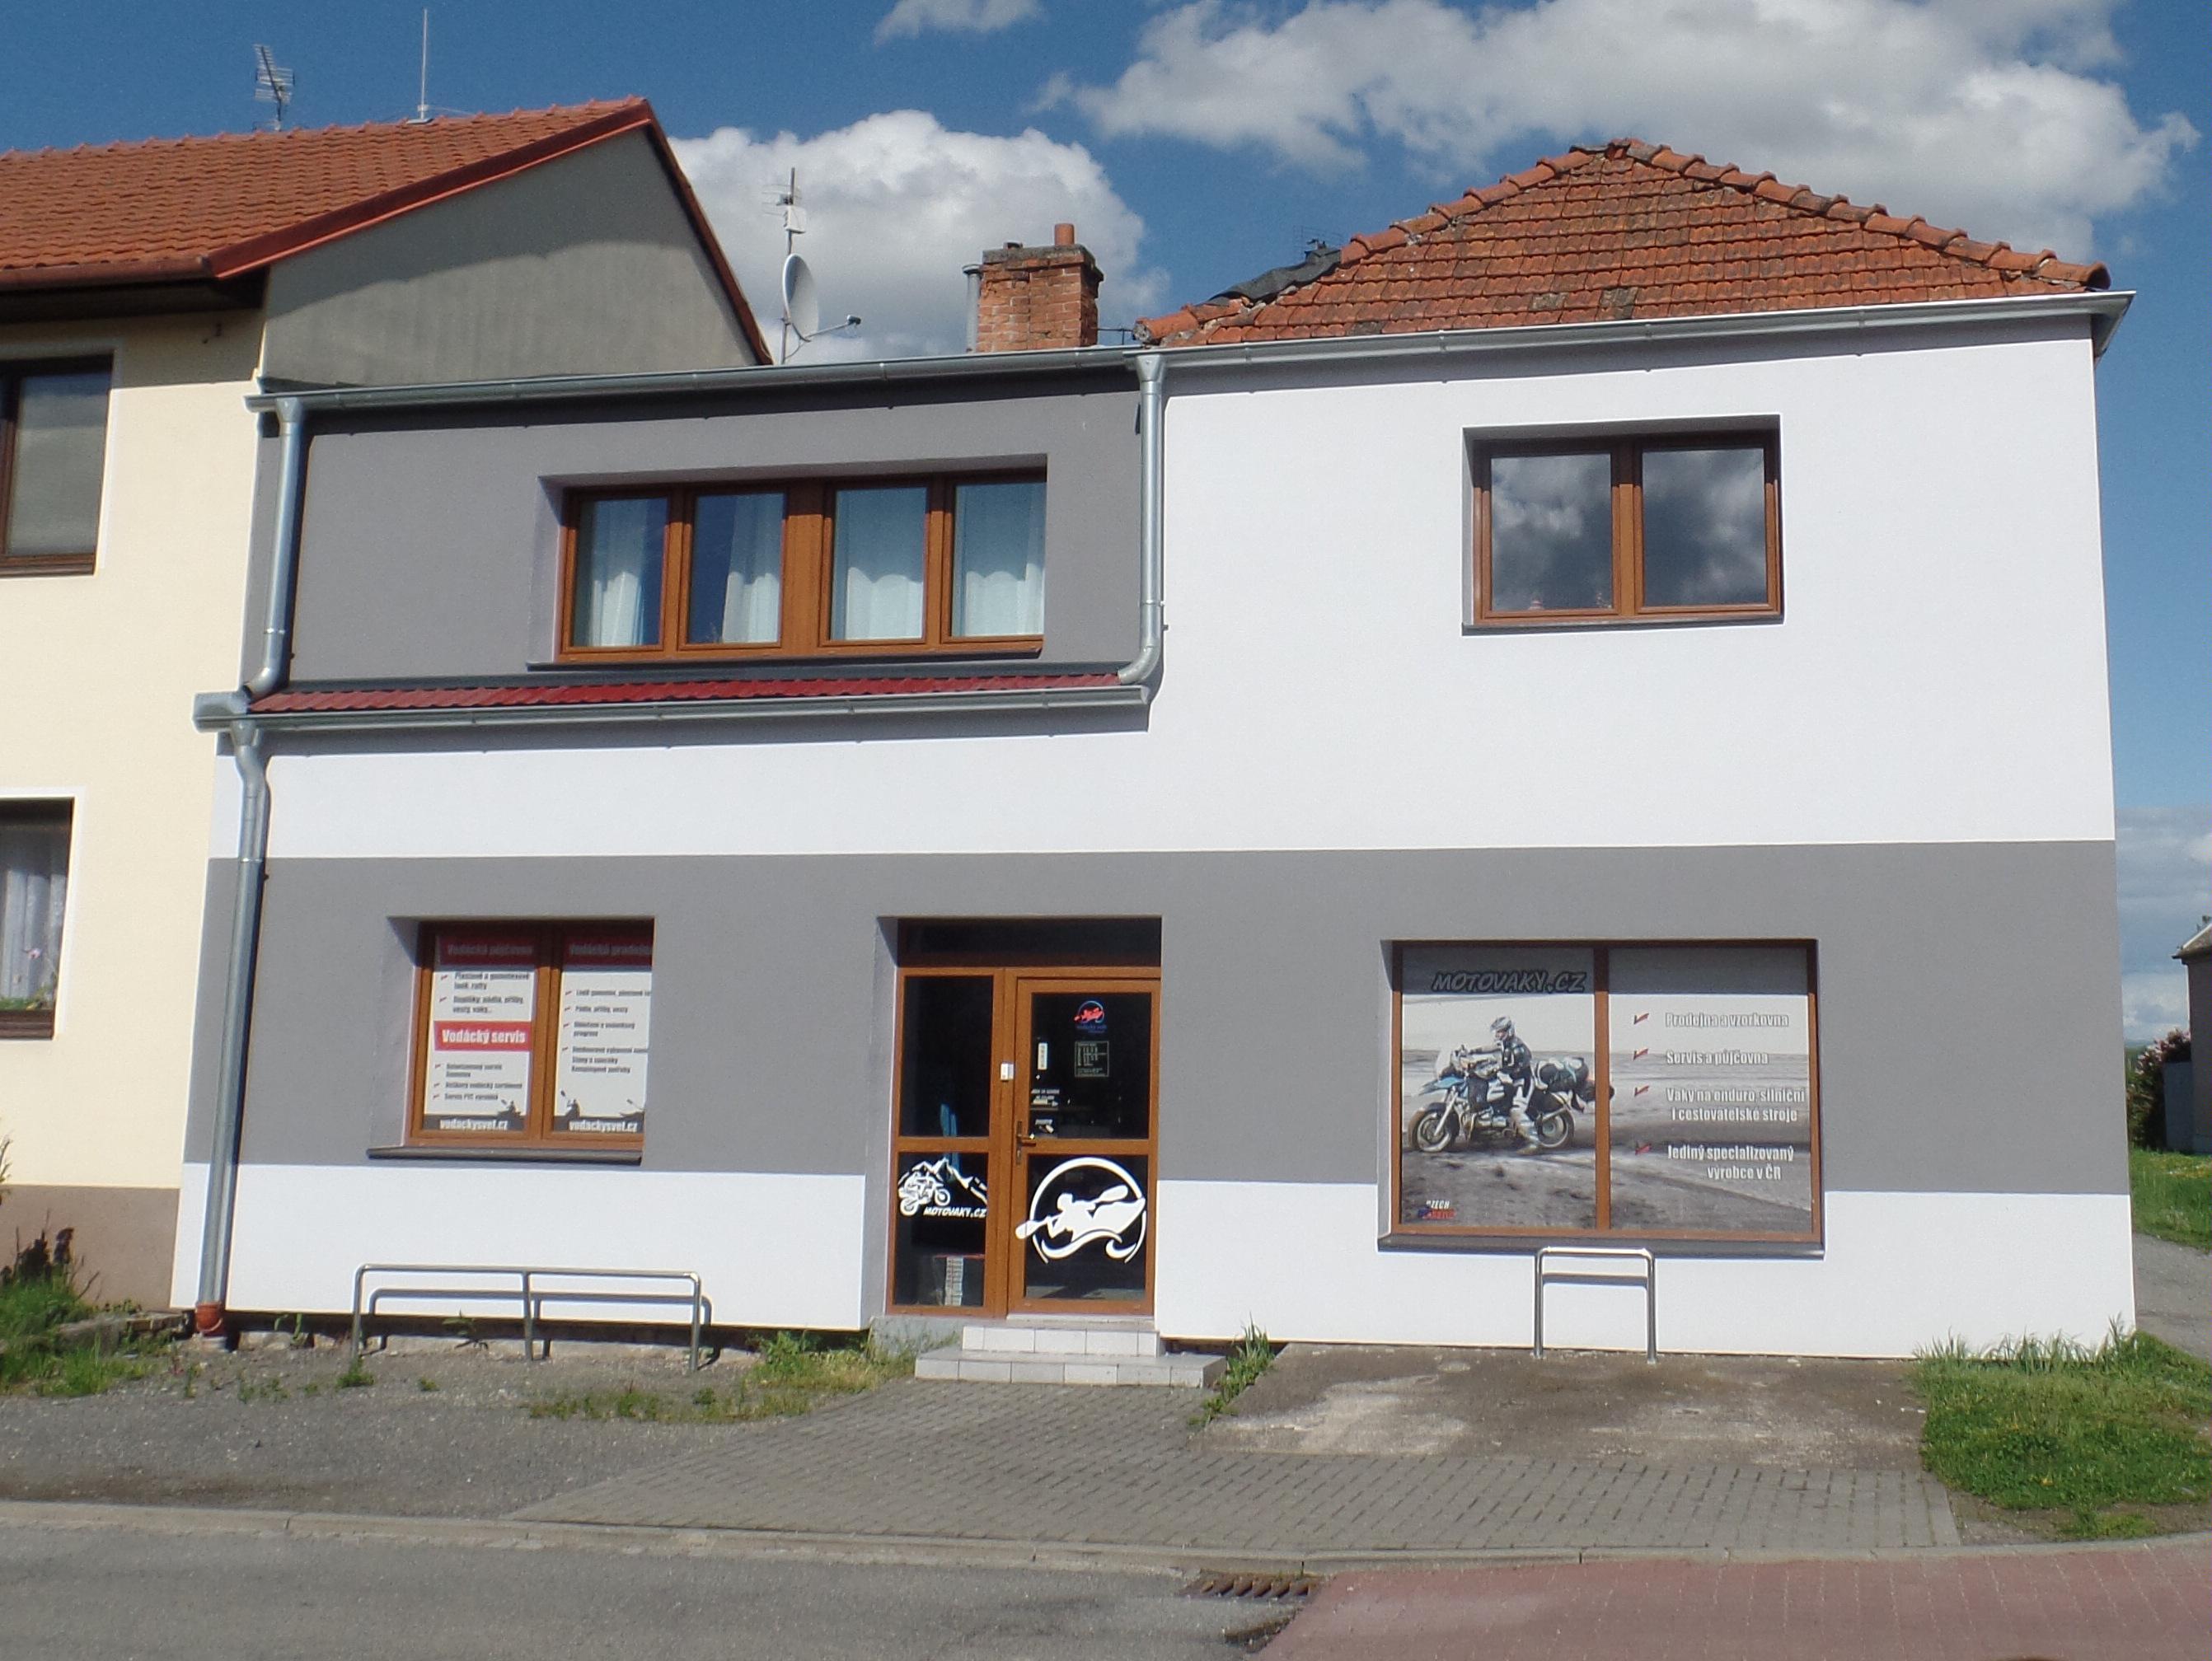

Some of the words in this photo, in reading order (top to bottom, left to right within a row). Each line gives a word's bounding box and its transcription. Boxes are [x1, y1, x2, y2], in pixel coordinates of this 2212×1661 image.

[1432, 970, 1587, 992] MOTOVAKY.CZ
[1666, 1013, 1719, 1027] Prodejna
[1720, 1015, 1729, 1027] a
[1730, 1013, 1789, 1027] vzorkovna
[442, 1028, 490, 1045] Vodácký
[491, 1029, 526, 1044] servis
[1666, 1050, 1704, 1064] Servis
[1705, 1053, 1713, 1064] a
[1714, 1048, 1769, 1065] půjčovna
[1666, 1087, 1694, 1102] Vaky
[1696, 1090, 1712, 1102] na
[1760, 1086, 1807, 1102] silniční
[1678, 1107, 1760, 1121] cestovatelské
[1762, 1107, 1798, 1123] stroje
[1667, 1144, 1704, 1161] Jediný
[1706, 1144, 1794, 1162] specializovaný
[1707, 1165, 1755, 1180] výrobce
[1756, 1167, 1763, 1180] v
[1764, 1163, 1782, 1180] ČR
[923, 1206, 987, 1219] MOTOVAKY.CZ
